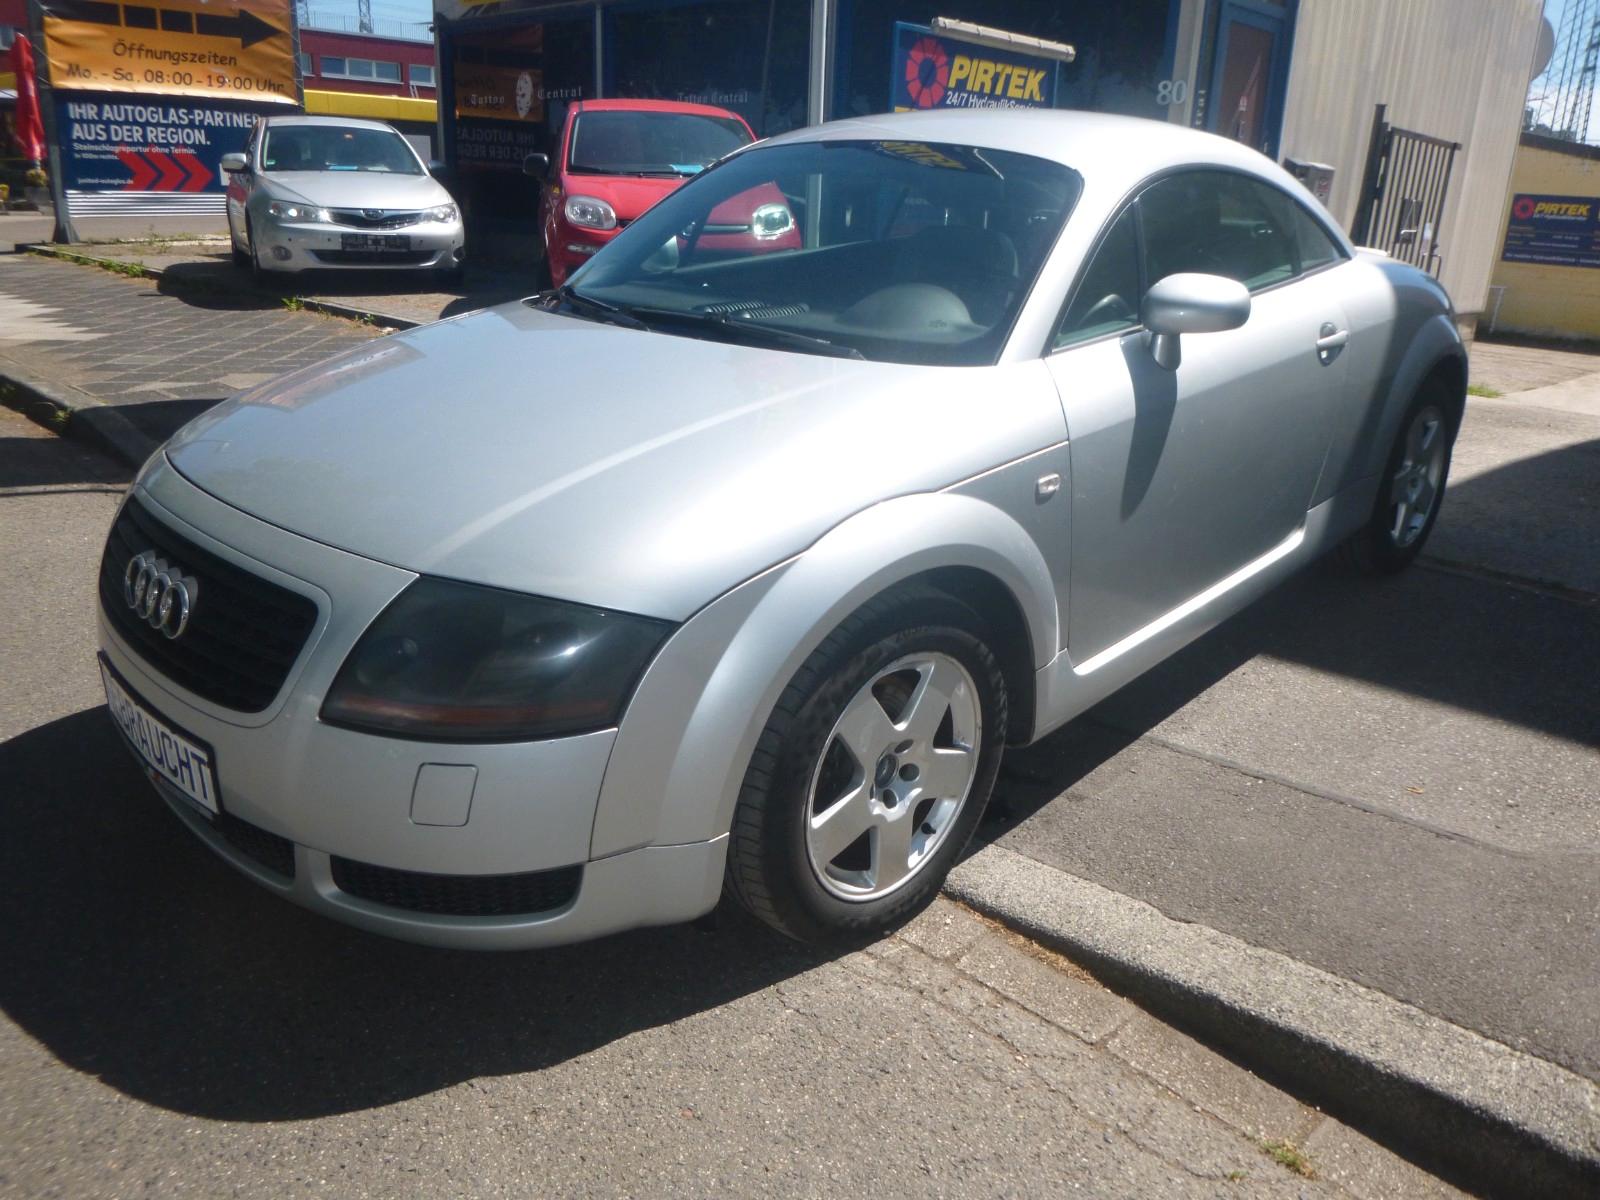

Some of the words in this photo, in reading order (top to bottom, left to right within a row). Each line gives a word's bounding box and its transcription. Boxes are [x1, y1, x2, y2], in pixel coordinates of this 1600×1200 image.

[112, 40, 237, 67] Öffnungszeiten
[112, 67, 140, 83] Sa.
[144, 69, 193, 86] 08:00
[206, 75, 252, 90] 19:00
[256, 79, 285, 93] Uhr
[948, 54, 1046, 101] PIRTEK
[946, 91, 967, 107] 24/7
[1156, 80, 1187, 105] 80
[68, 102, 98, 120] IHR
[72, 124, 107, 141] AUS
[111, 126, 143, 143] DER
[147, 127, 211, 145] REGION.
[1535, 202, 1591, 216] PIRTEK
